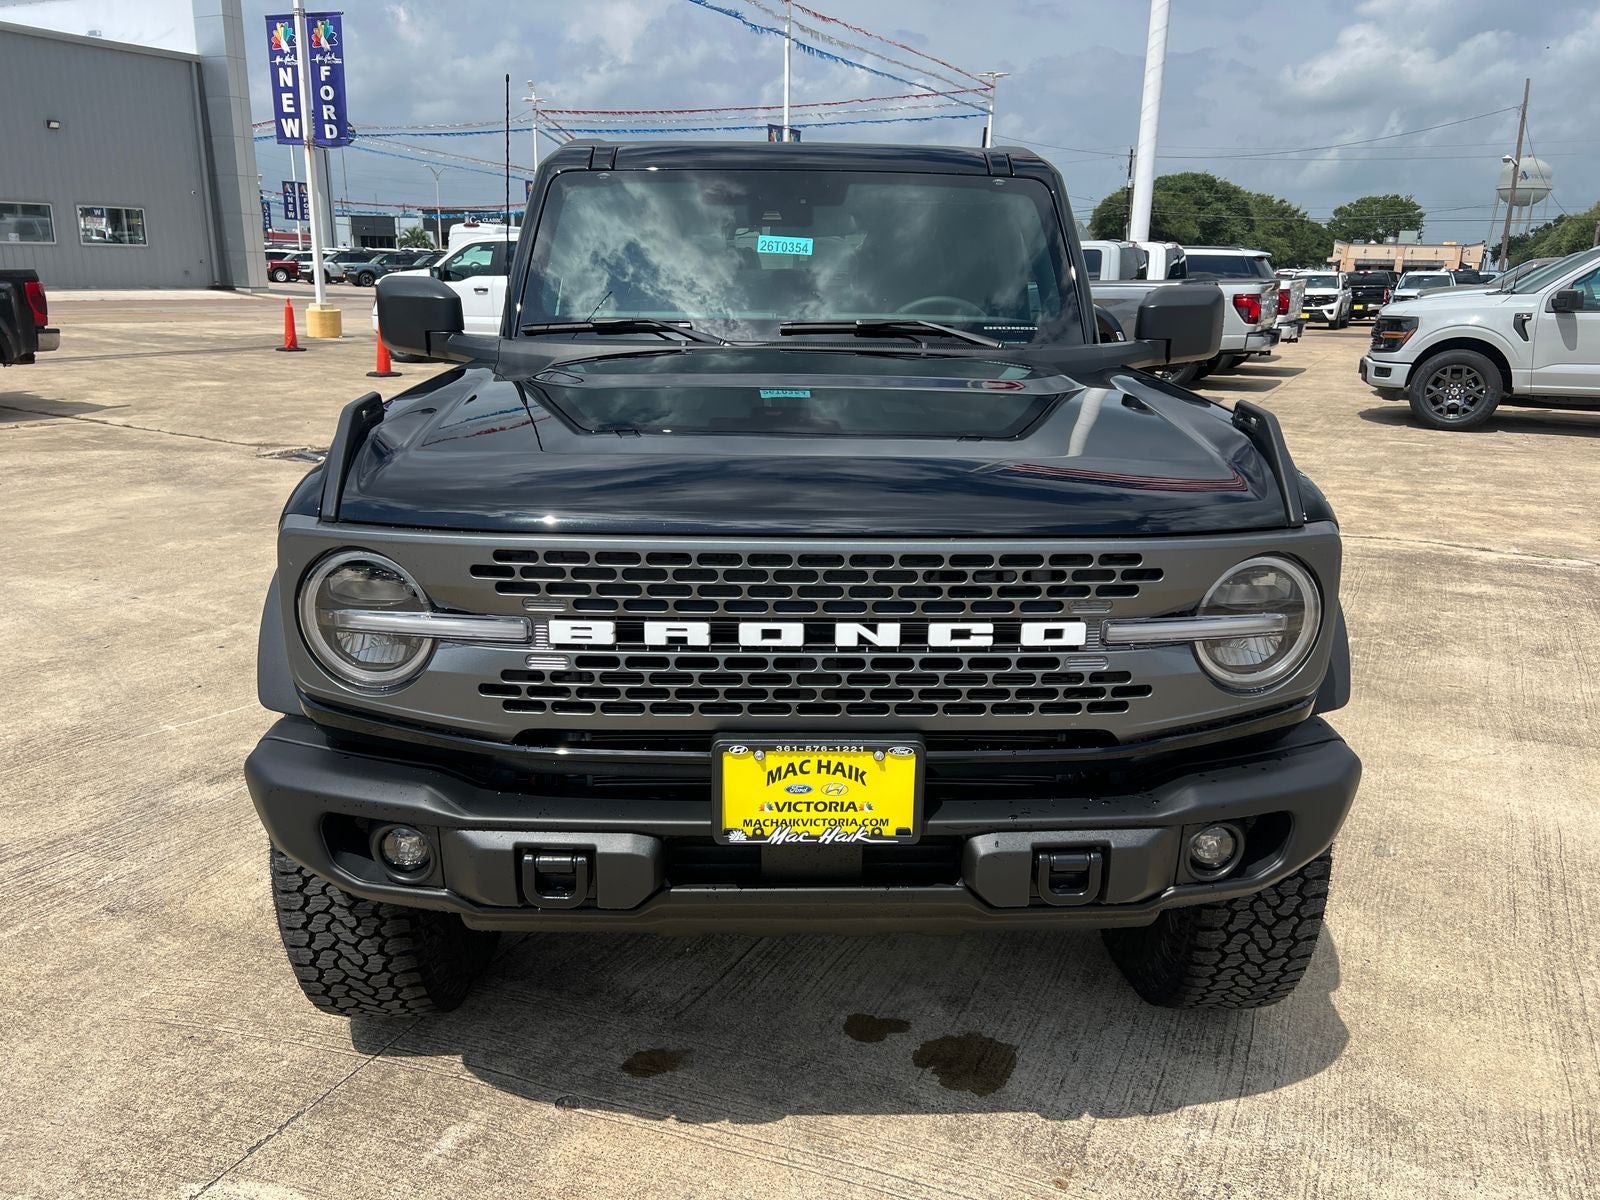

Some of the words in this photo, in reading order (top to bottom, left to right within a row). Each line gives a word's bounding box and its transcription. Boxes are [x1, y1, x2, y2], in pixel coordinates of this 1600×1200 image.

[278, 67, 299, 138] NEW
[320, 66, 338, 139] FORD
[287, 196, 295, 218] NEW
[760, 239, 809, 254] 26T0354
[548, 620, 1088, 648] BRONCO
[766, 759, 811, 787] MAC
[817, 759, 867, 787] HAIK
[774, 801, 858, 812] VICTORIA
[743, 818, 889, 828] MACHAIKVICTORIA.COM
[767, 825, 810, 844] Mac
[818, 825, 870, 844] Haik
